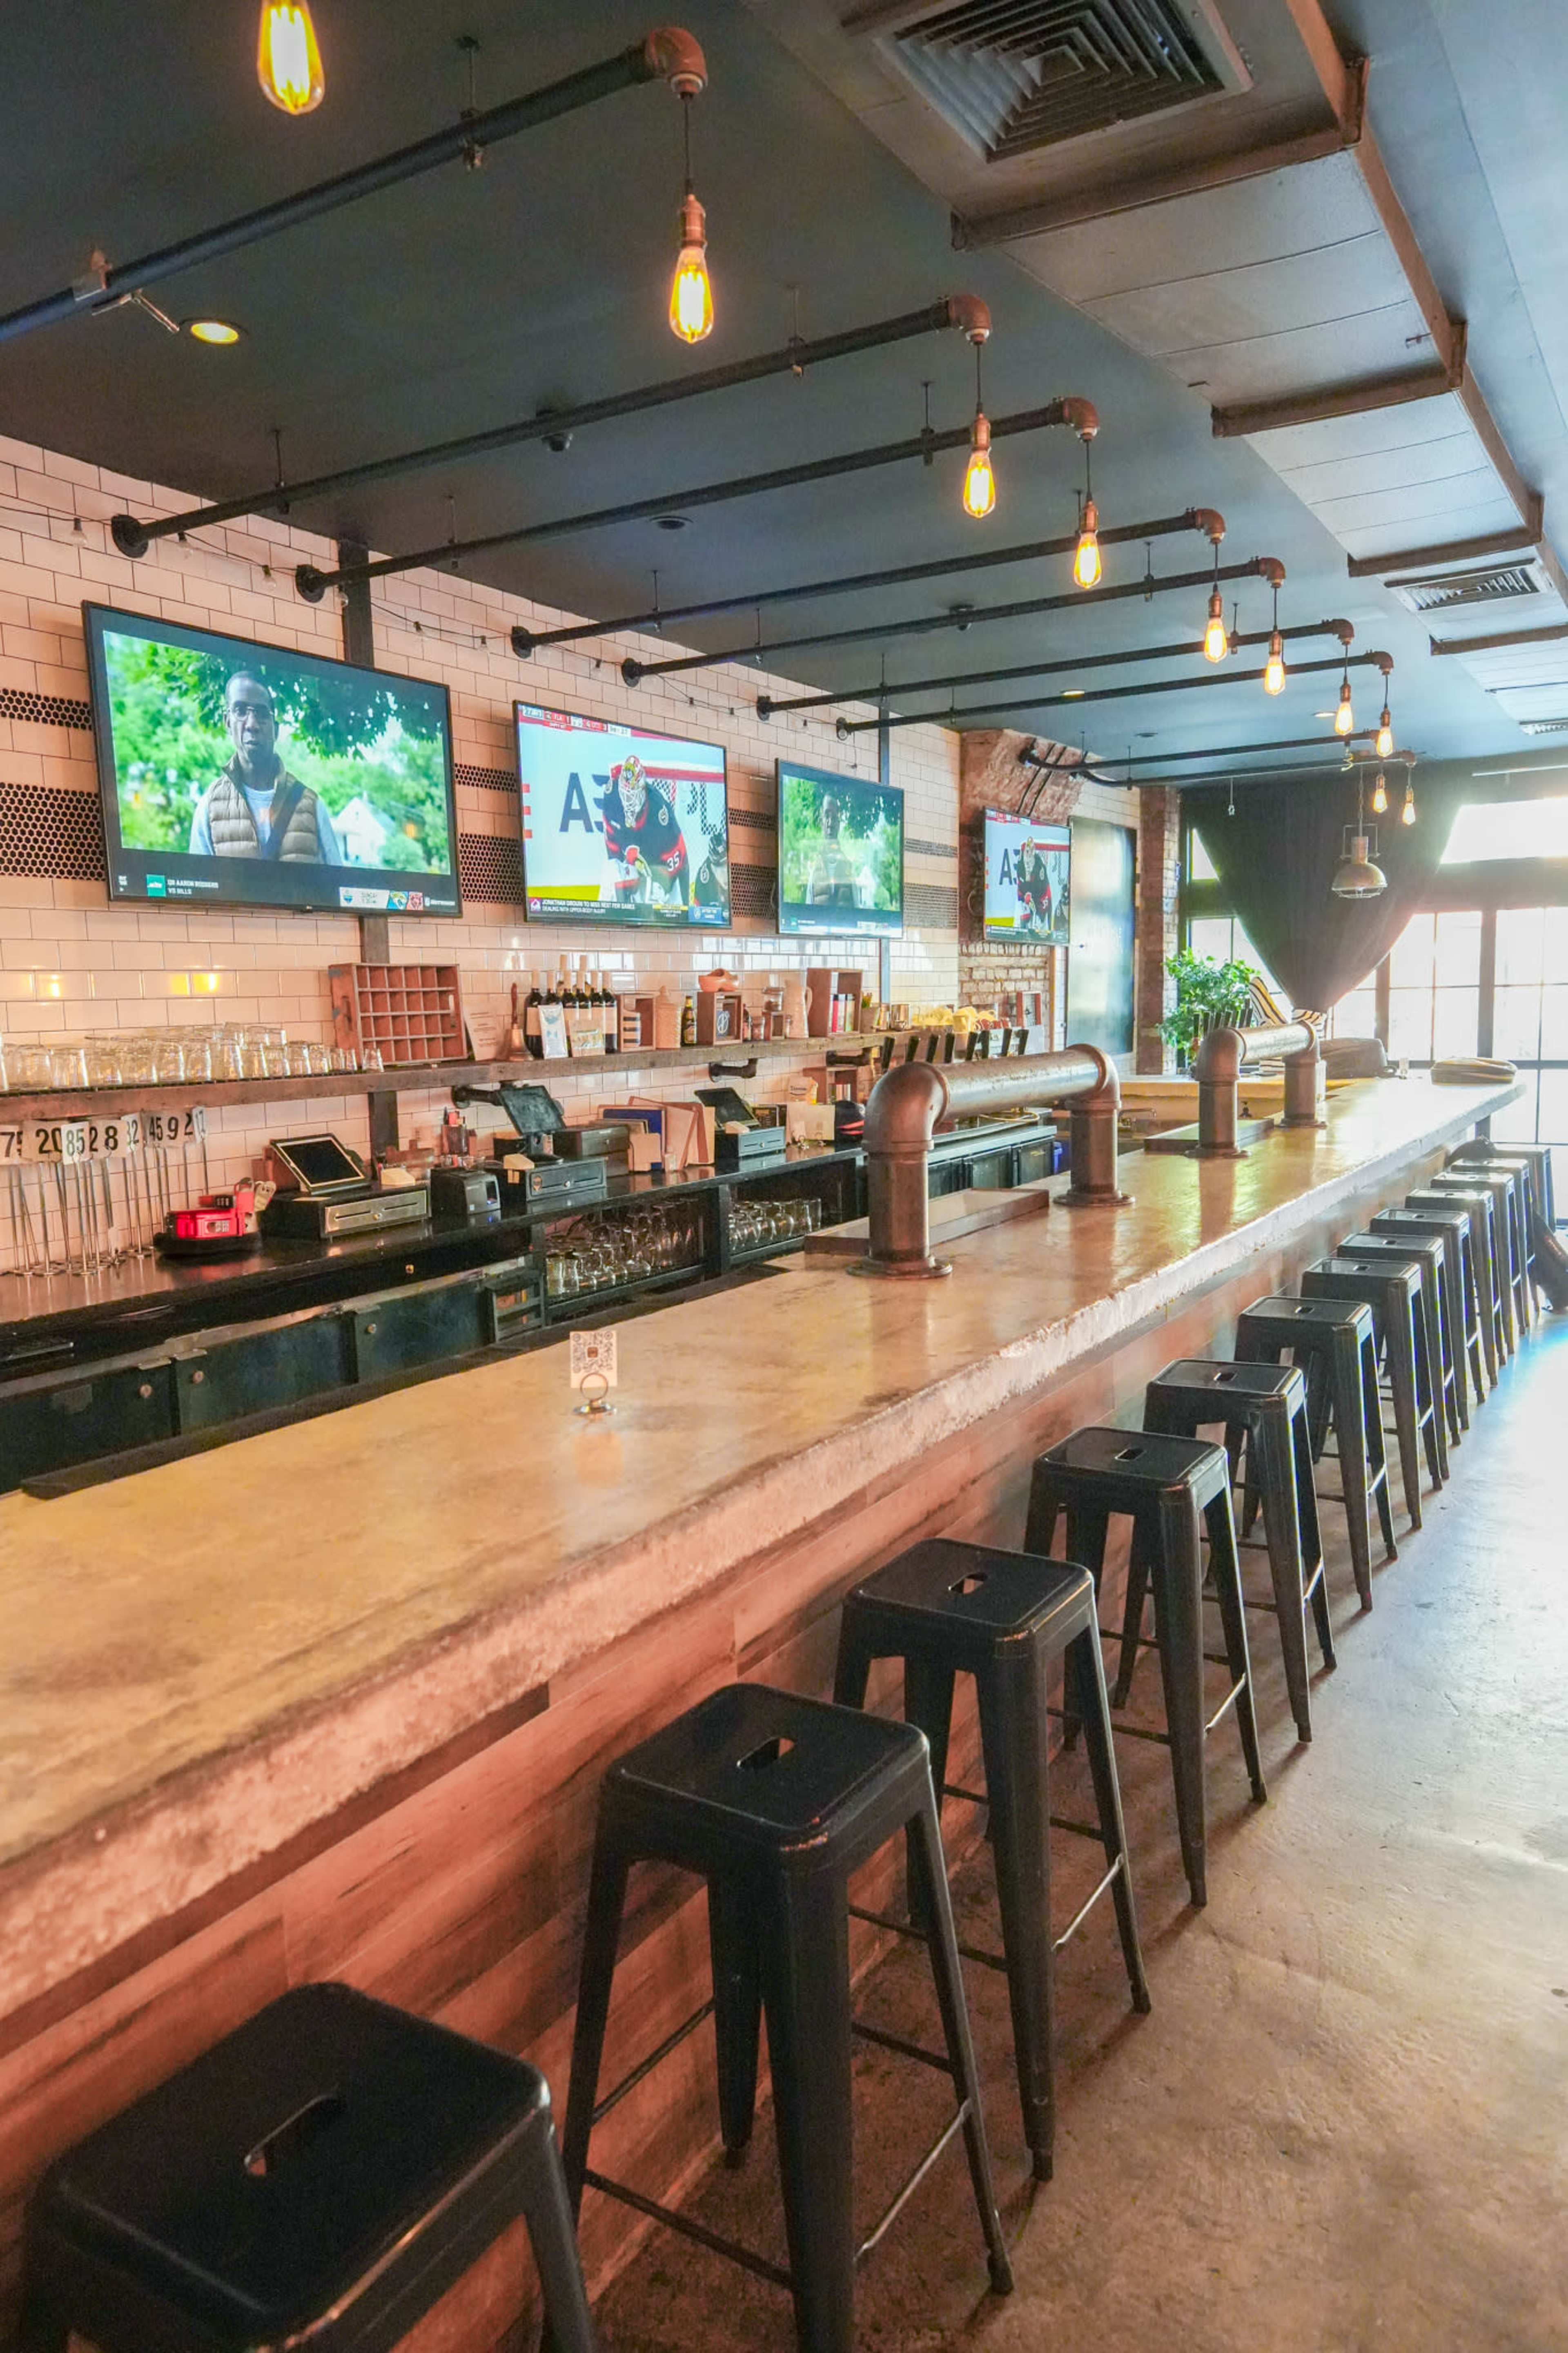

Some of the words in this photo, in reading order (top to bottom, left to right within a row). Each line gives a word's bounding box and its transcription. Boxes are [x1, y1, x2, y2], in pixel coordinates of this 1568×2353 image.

[667, 851, 680, 872] 35
[149, 1116, 163, 1141] 45
[66, 1128, 85, 1156] 85
